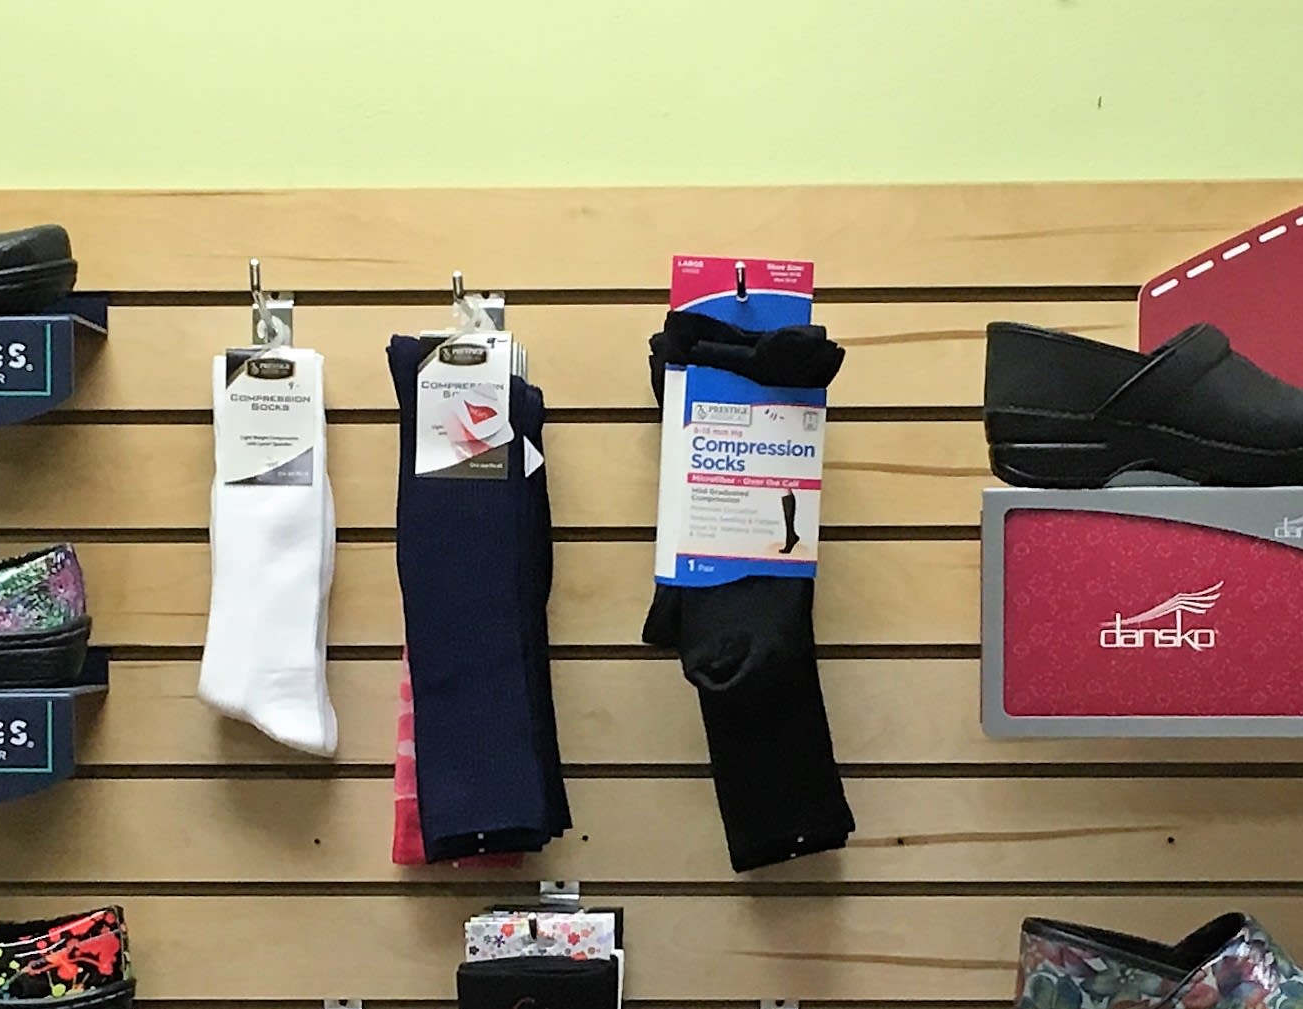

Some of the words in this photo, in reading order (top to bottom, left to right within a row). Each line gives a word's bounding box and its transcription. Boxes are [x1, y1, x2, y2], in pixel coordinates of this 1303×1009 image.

[230, 394, 311, 403] COMPRESSION
[251, 403, 290, 411] SOCKS
[692, 436, 815, 458] Compression
[691, 453, 746, 472] Socks
[688, 559, 695, 572] 1
[1099, 610, 1215, 651] dansko
